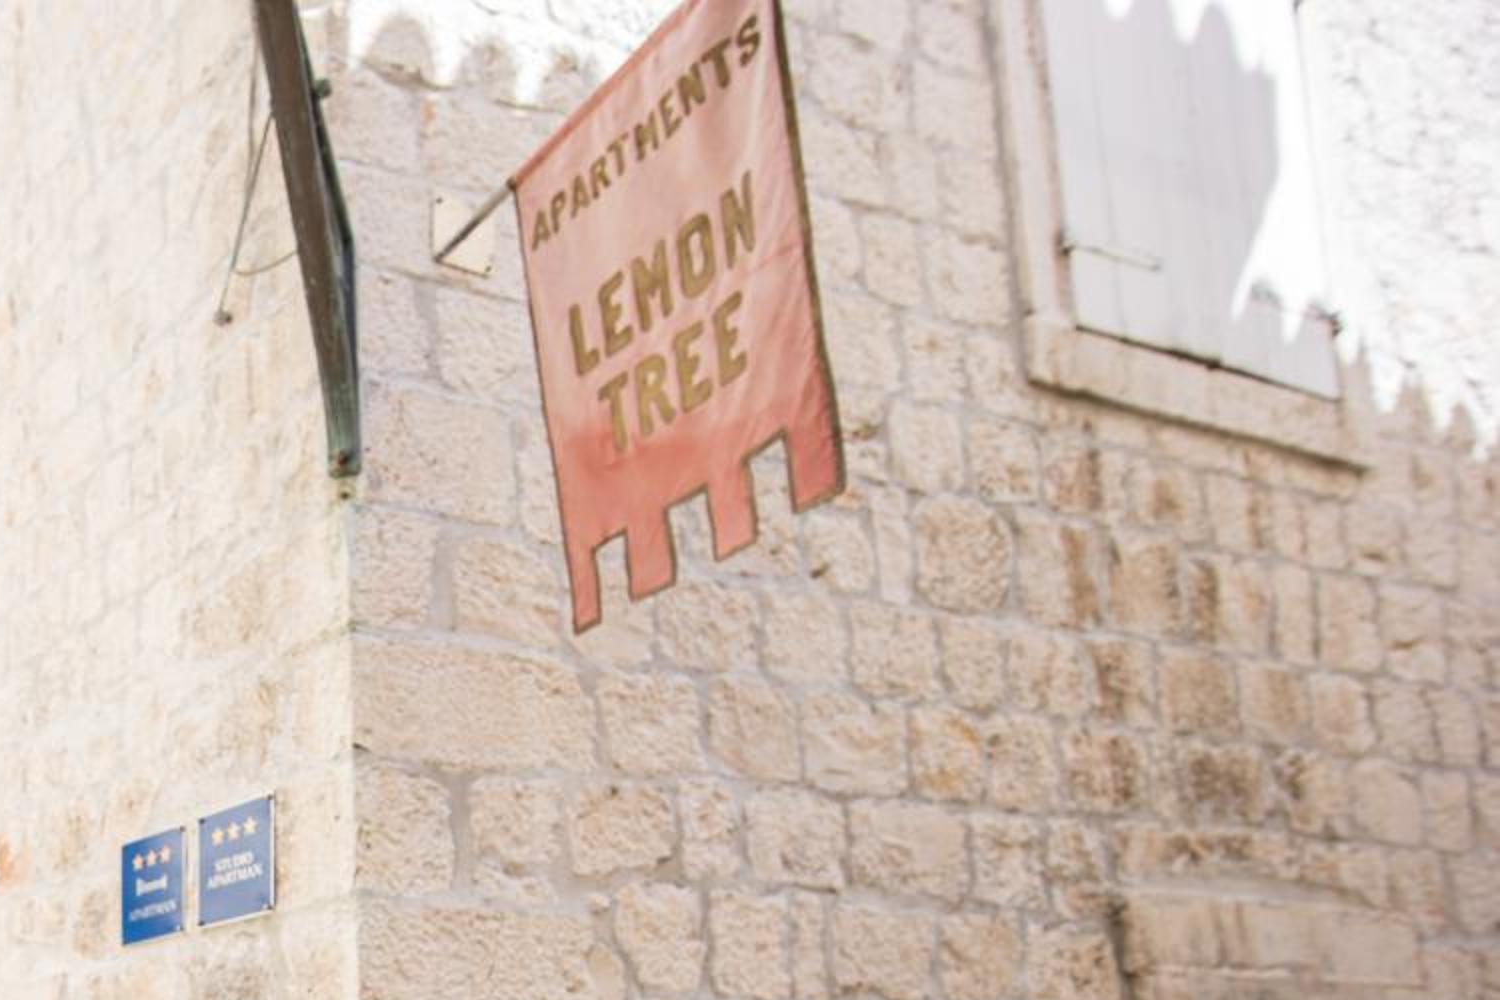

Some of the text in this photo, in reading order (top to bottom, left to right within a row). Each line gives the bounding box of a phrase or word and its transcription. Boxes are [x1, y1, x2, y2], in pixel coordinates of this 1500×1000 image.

[532, 14, 761, 250] APARTMENTS
[568, 171, 756, 377] LEMON
[598, 292, 748, 452] TREE
